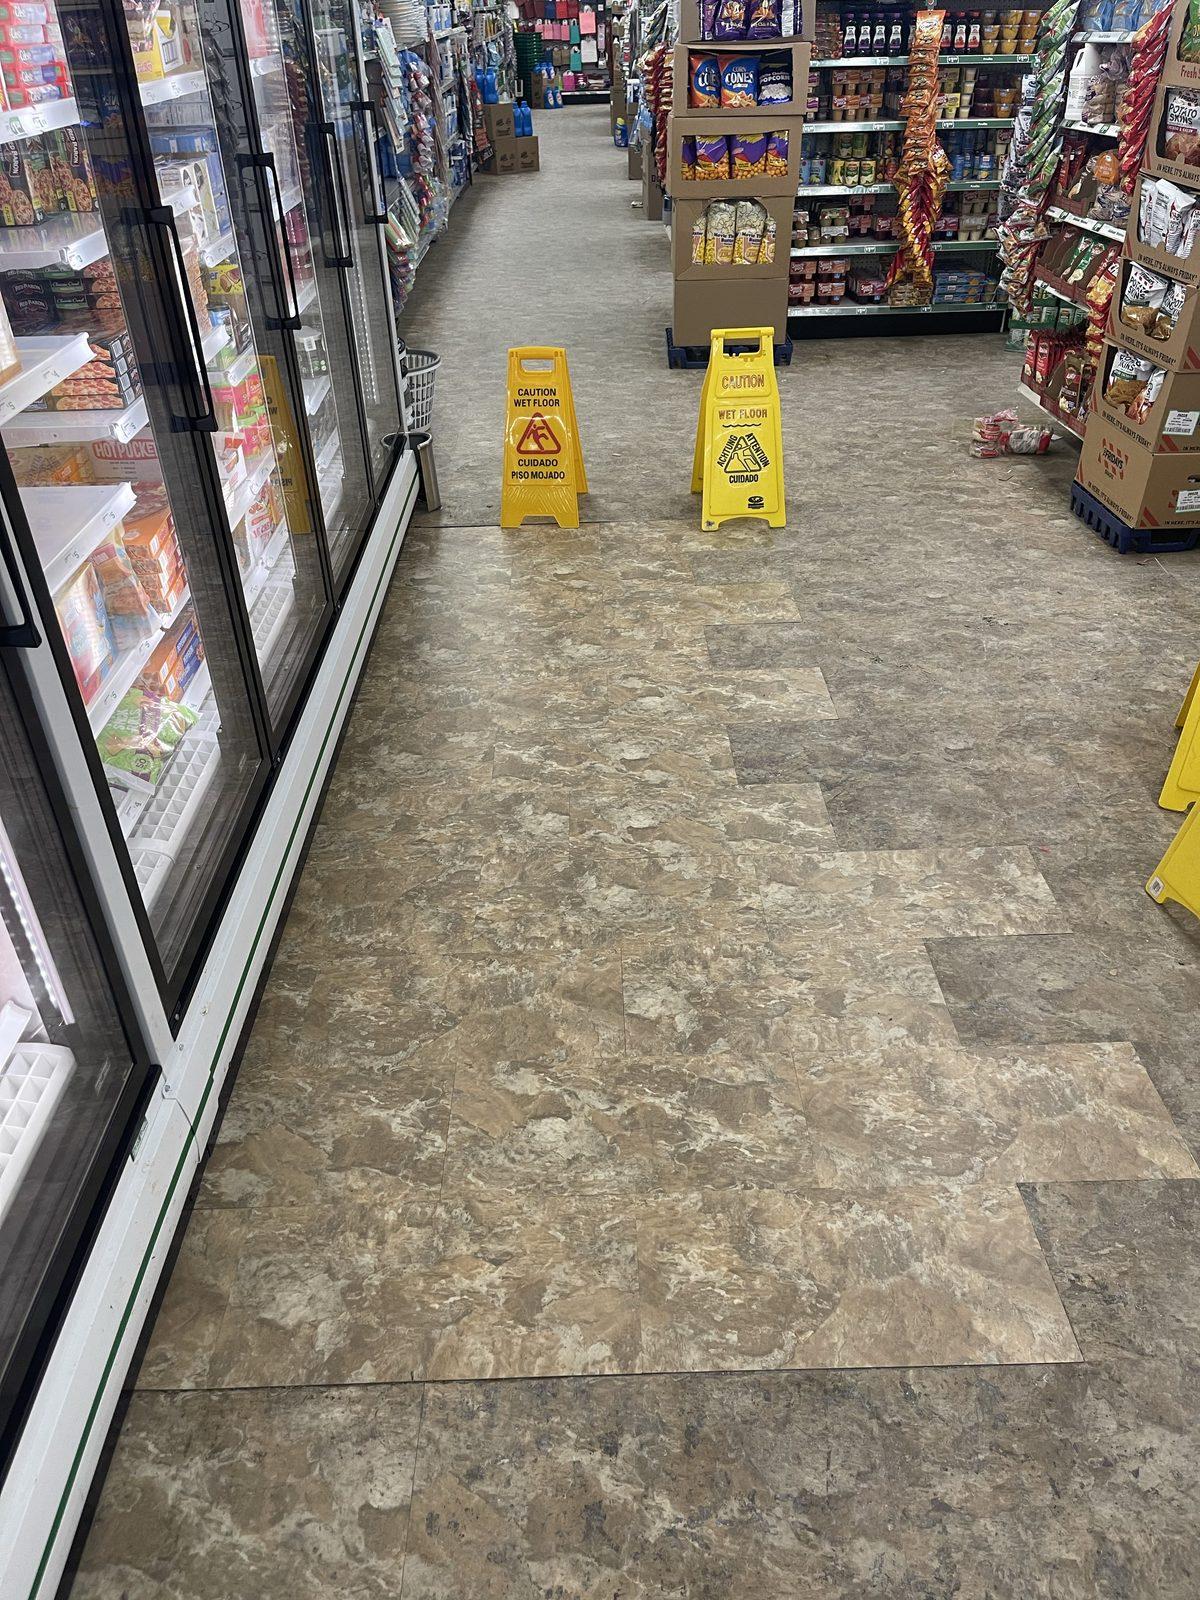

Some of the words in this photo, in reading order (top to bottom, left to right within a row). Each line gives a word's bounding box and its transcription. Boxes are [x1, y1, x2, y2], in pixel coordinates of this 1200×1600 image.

[725, 71, 754, 85] CONES
[1181, 65, 1198, 79] Fresh
[1169, 103, 1198, 119] POTATO
[1169, 113, 1193, 125] SKINS
[722, 374, 765, 389] CAUTION
[517, 388, 557, 397] CAUTION
[513, 399, 532, 408] WET
[533, 398, 560, 408] FLOOR
[718, 409, 737, 420] WET
[739, 408, 768, 419] FLOOR
[94, 442, 118, 458] HOT
[118, 440, 156, 458] POCKE
[716, 434, 738, 468] ACHTUNG
[745, 433, 771, 468] ATTENTION
[518, 459, 558, 467] CUIDADO
[511, 471, 530, 480] PISO
[530, 471, 566, 480] MOJADO
[728, 474, 759, 484] CUIDADO
